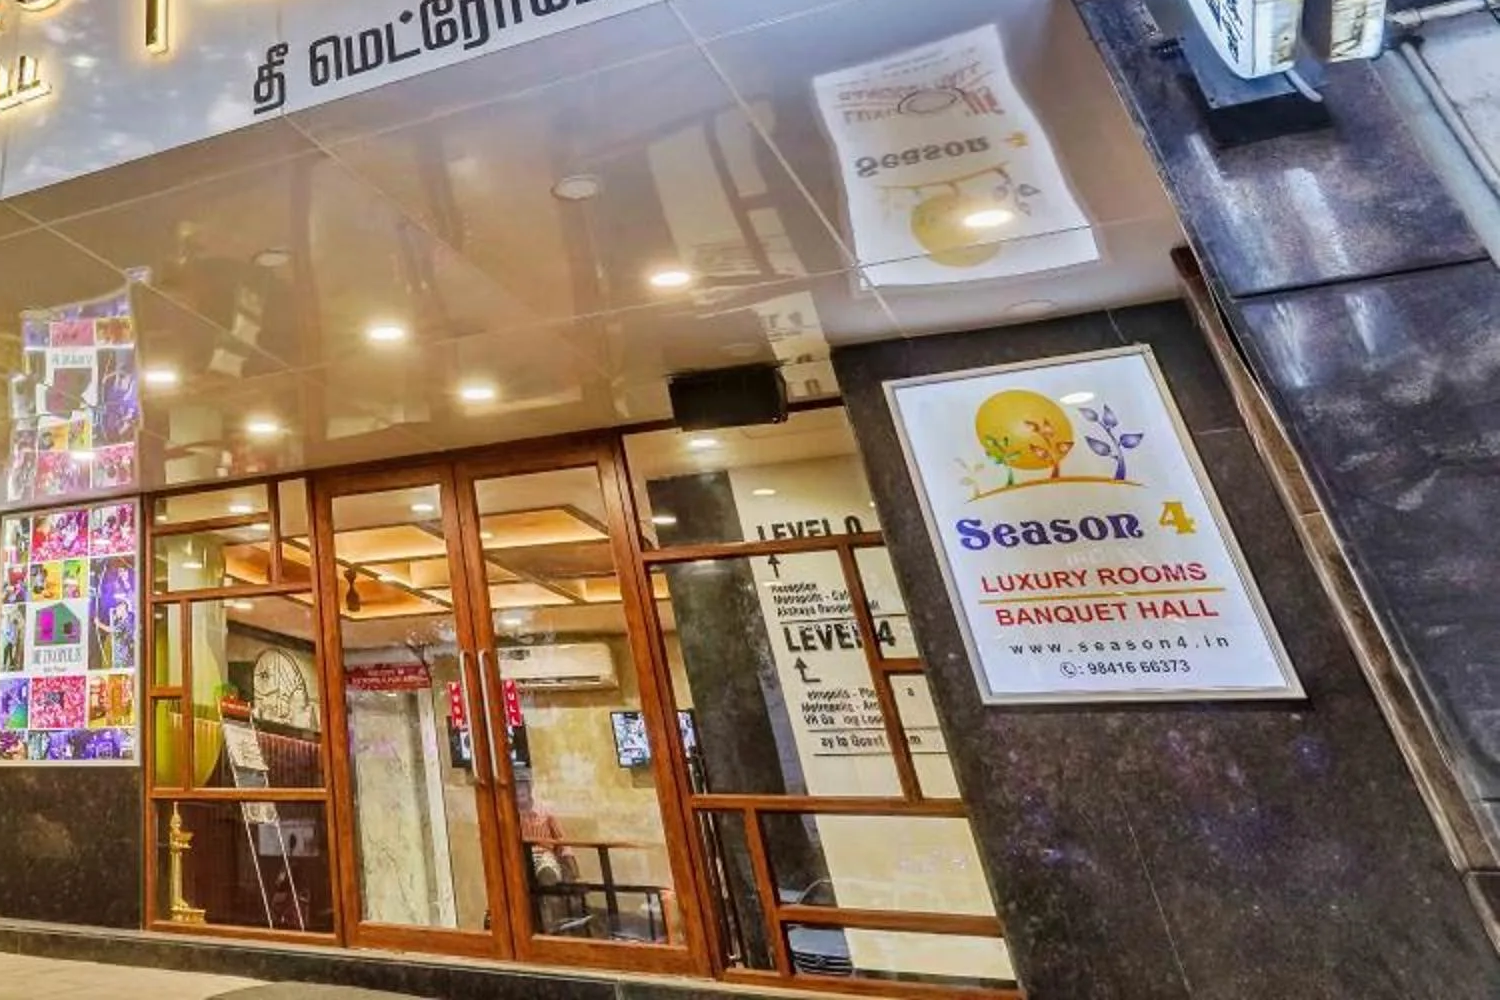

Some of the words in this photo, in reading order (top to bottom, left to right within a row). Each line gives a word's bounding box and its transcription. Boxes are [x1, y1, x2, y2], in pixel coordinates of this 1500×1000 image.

[252, 41, 291, 115] தீ
[955, 512, 1145, 551] Season
[1157, 501, 1197, 535] 4
[980, 568, 1088, 594] LUXURY
[1097, 562, 1208, 586] ROOMS
[994, 602, 1128, 627] BANQUET
[1136, 599, 1220, 620] HALL
[877, 619, 896, 647] 4
[505, 679, 522, 726] PULL
